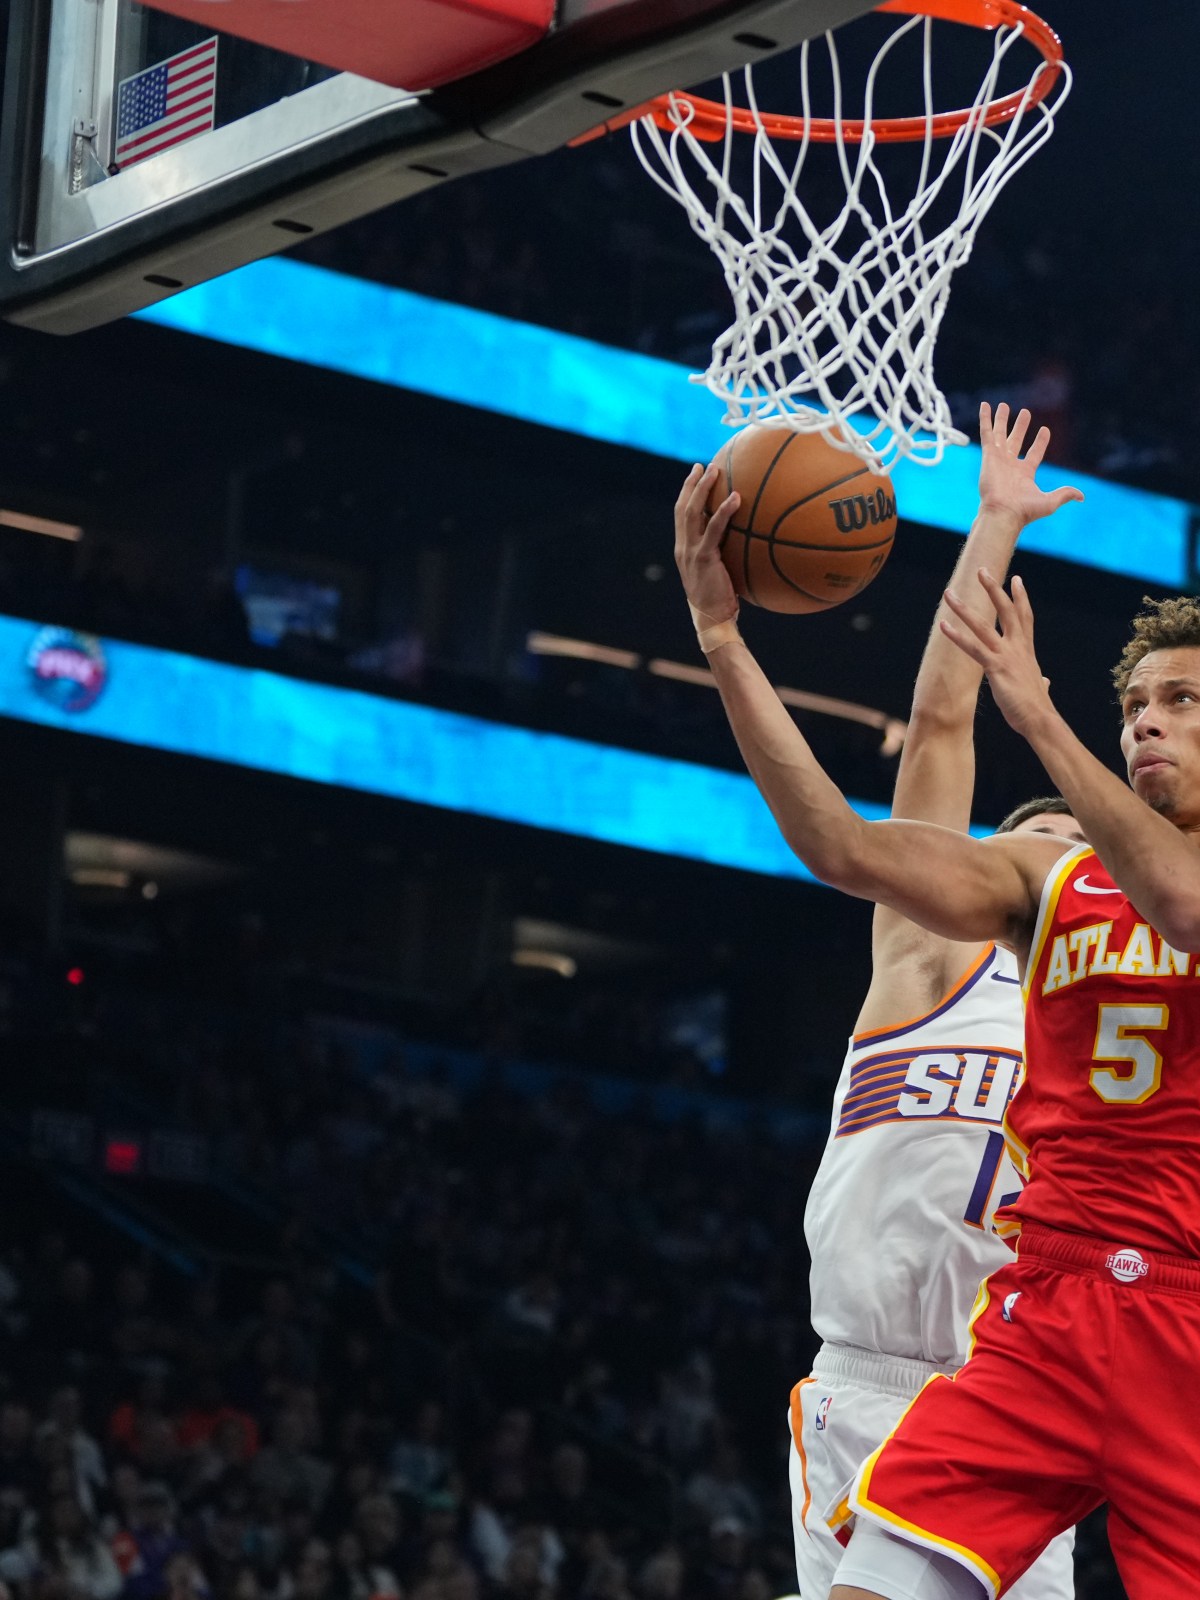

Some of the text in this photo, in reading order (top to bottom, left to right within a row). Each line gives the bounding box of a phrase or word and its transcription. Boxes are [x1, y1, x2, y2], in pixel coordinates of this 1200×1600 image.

[828, 486, 897, 533] Wils
[896, 1052, 1026, 1122] SU
[1089, 1003, 1169, 1104] 5
[963, 1129, 1026, 1235] 1
[1105, 1255, 1149, 1276] HAWKS
